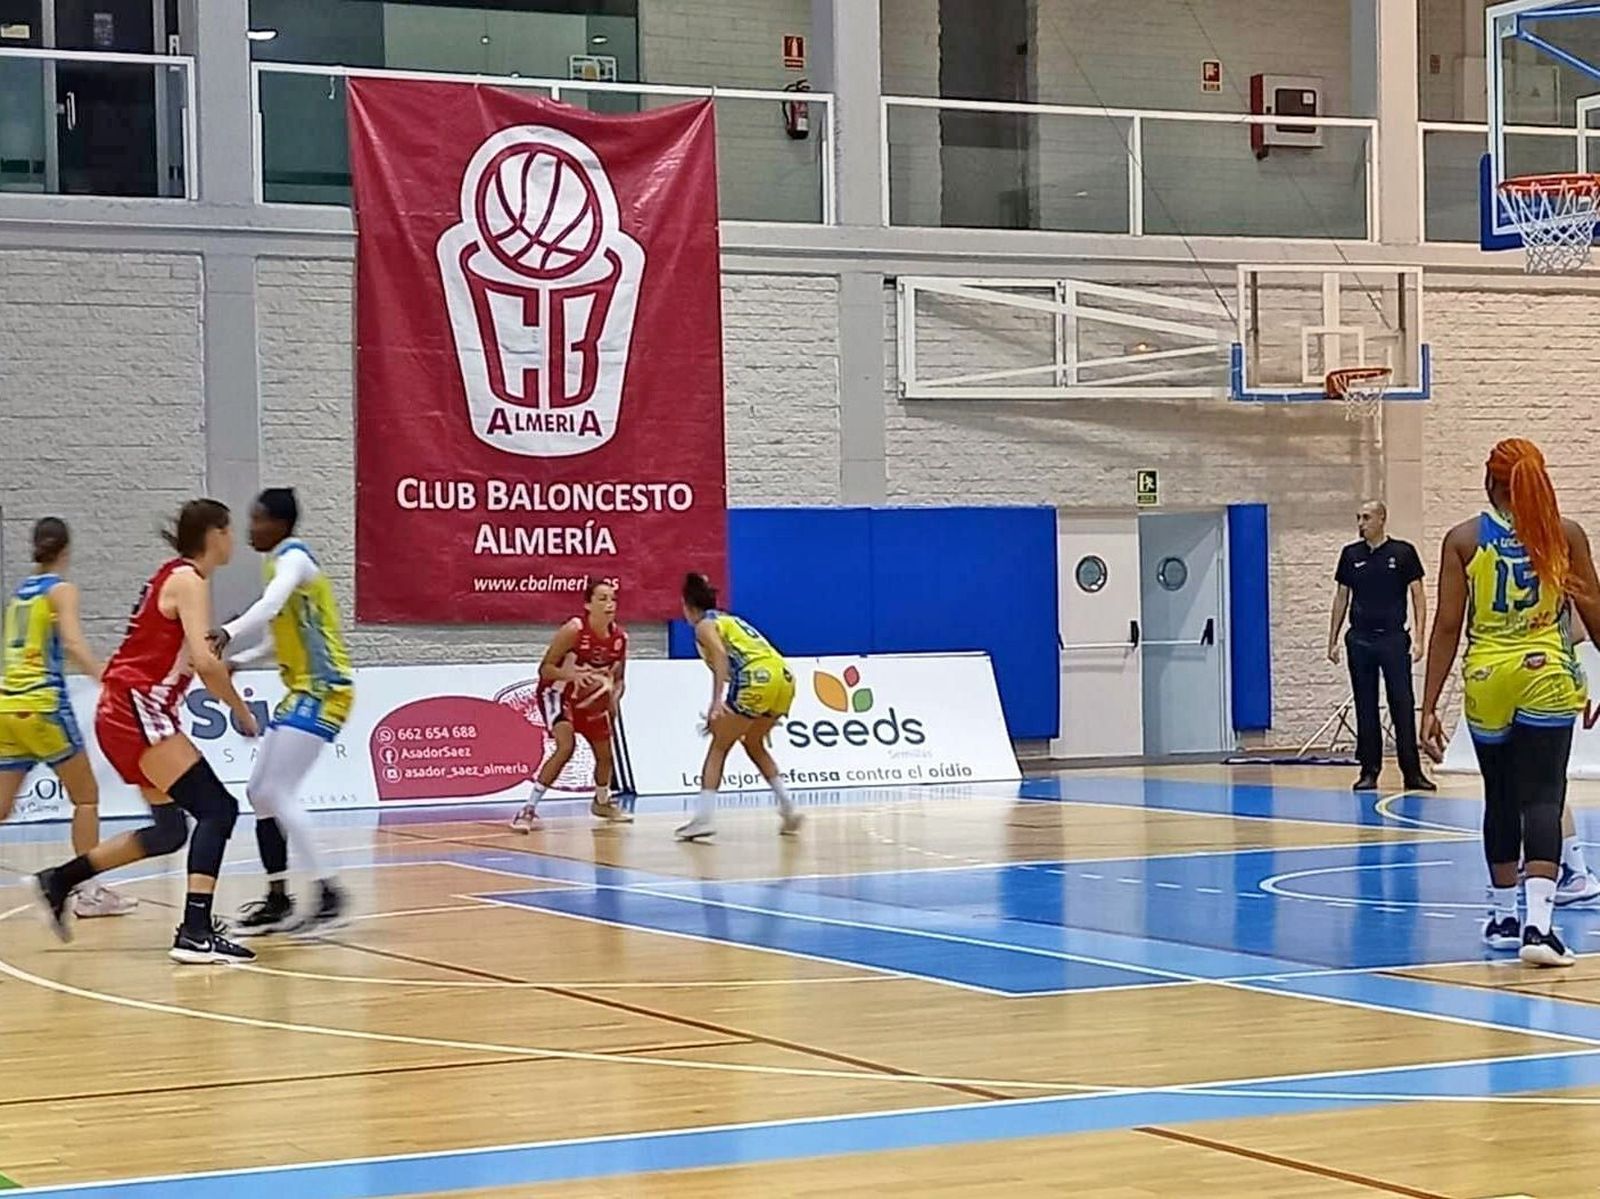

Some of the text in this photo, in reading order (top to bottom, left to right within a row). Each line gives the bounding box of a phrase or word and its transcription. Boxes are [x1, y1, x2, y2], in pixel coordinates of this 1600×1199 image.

[486, 407, 602, 437] ALMERIA
[396, 477, 693, 511] CLUB BALONCESTO
[474, 519, 617, 555] ALMERÍA
[1492, 558, 1540, 613] 15
[398, 725, 477, 741] 662 654 688
[401, 746, 472, 760] AsadorSaez
[404, 762, 529, 779] asador_saez_almeria
[721, 771, 761, 788] ejor
[779, 768, 841, 784] efensa
[846, 767, 902, 781] contra
[908, 764, 922, 779] el
[928, 762, 973, 778] oídio
